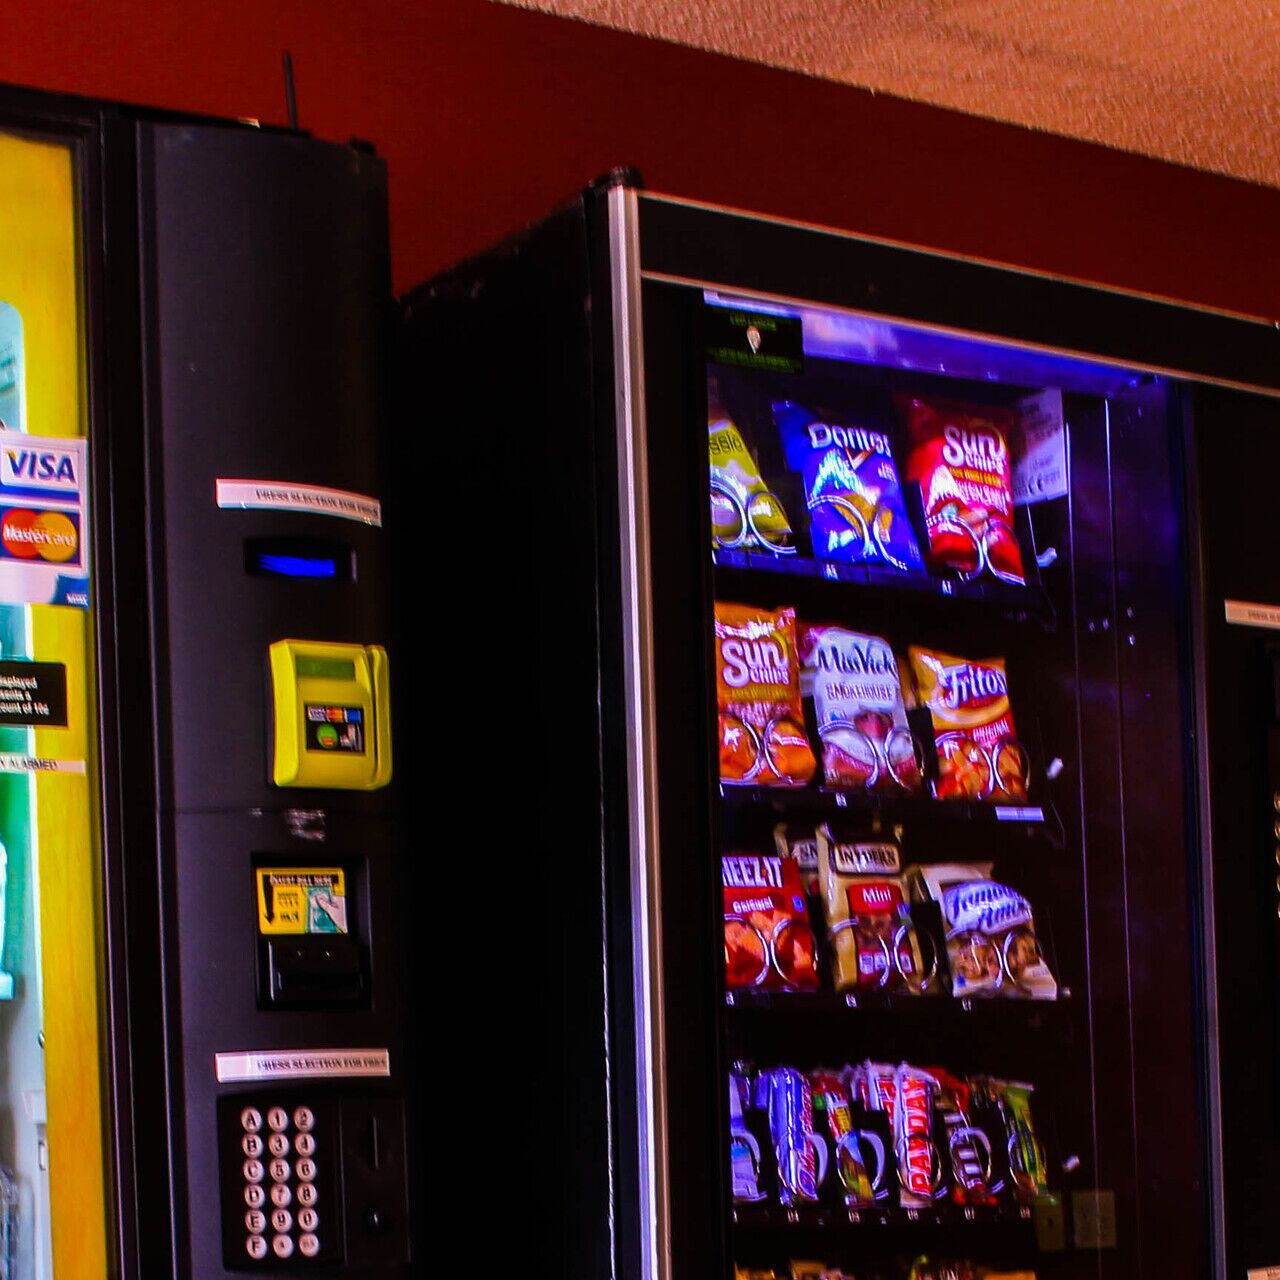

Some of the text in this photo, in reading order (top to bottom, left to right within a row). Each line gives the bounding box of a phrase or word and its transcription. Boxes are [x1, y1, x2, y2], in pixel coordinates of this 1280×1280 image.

[7, 450, 77, 483] VISA
[722, 638, 789, 687] Sun
[946, 663, 1007, 710] Fritos
[9, 758, 59, 771] ALARMED
[862, 887, 893, 903] Mini
